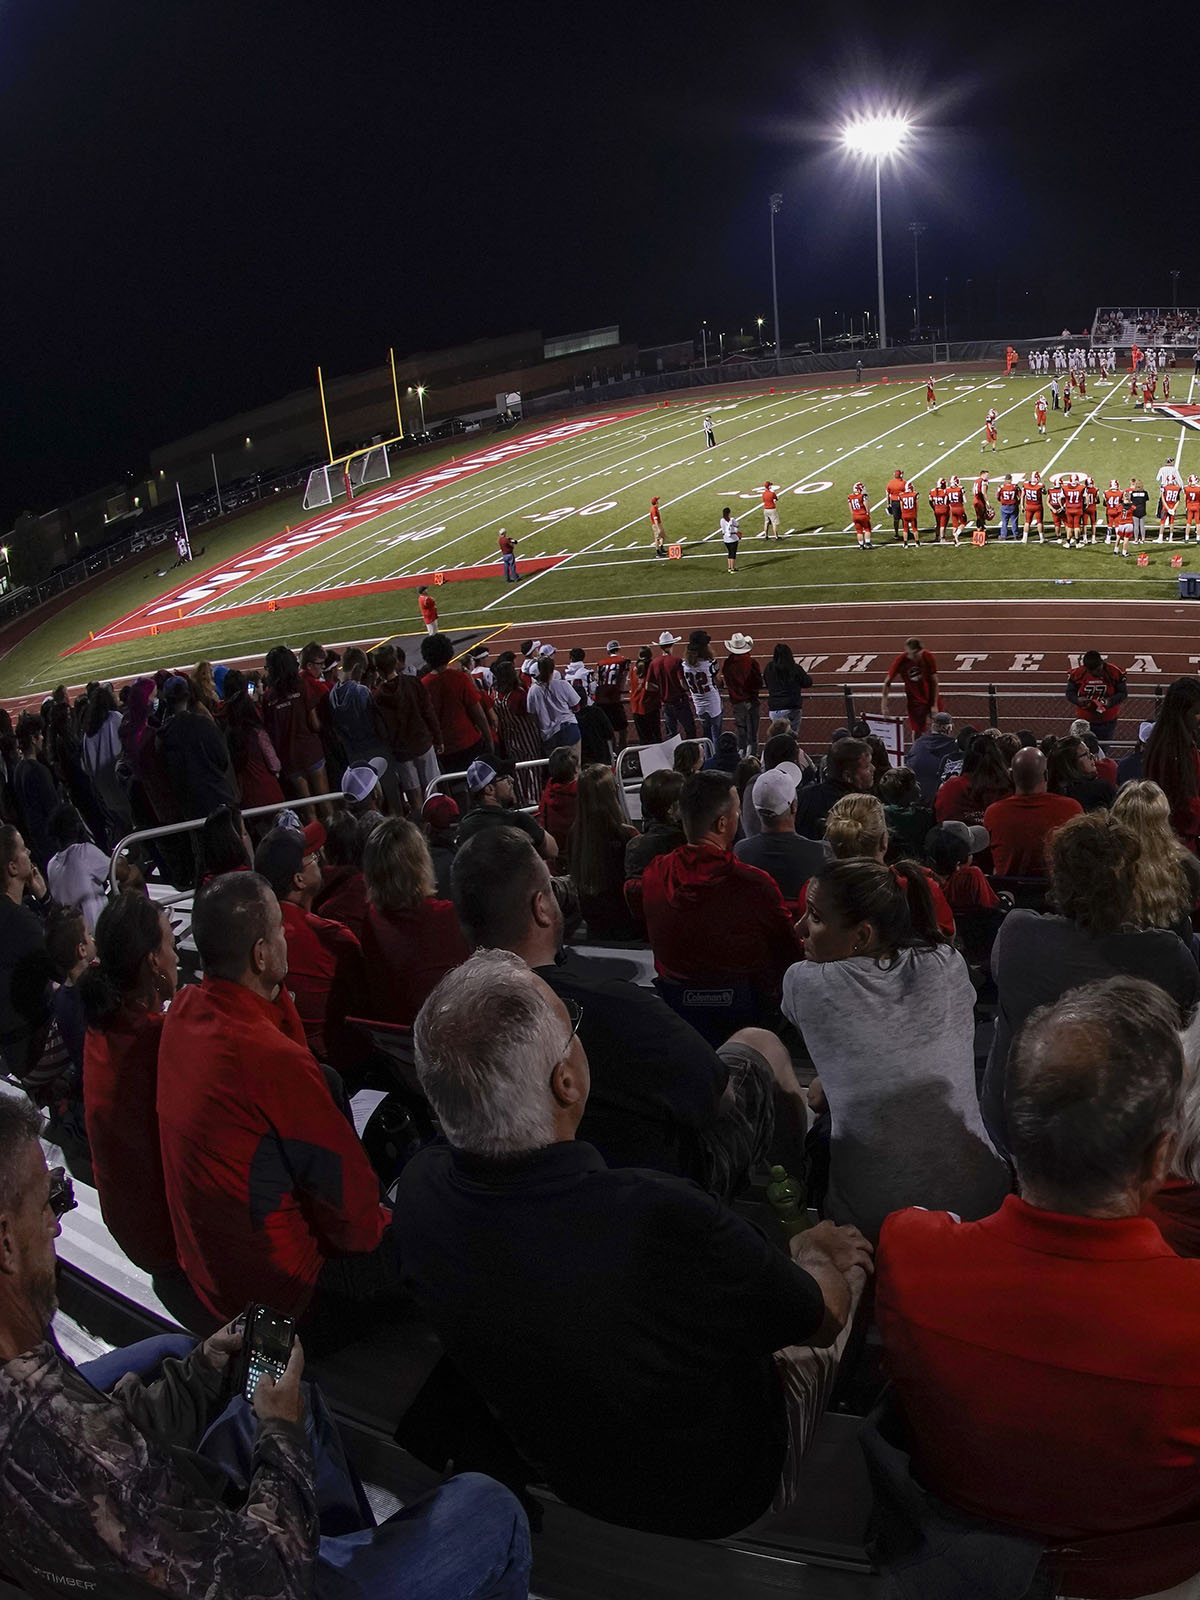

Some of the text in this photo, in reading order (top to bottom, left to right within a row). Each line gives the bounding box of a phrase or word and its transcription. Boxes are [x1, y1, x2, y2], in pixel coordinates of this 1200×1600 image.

[1025, 489, 1038, 501] 55
[1067, 490, 1080, 503] 77
[1165, 490, 1177, 502] 88
[902, 497, 914, 509] 30
[1108, 496, 1120, 508] 44
